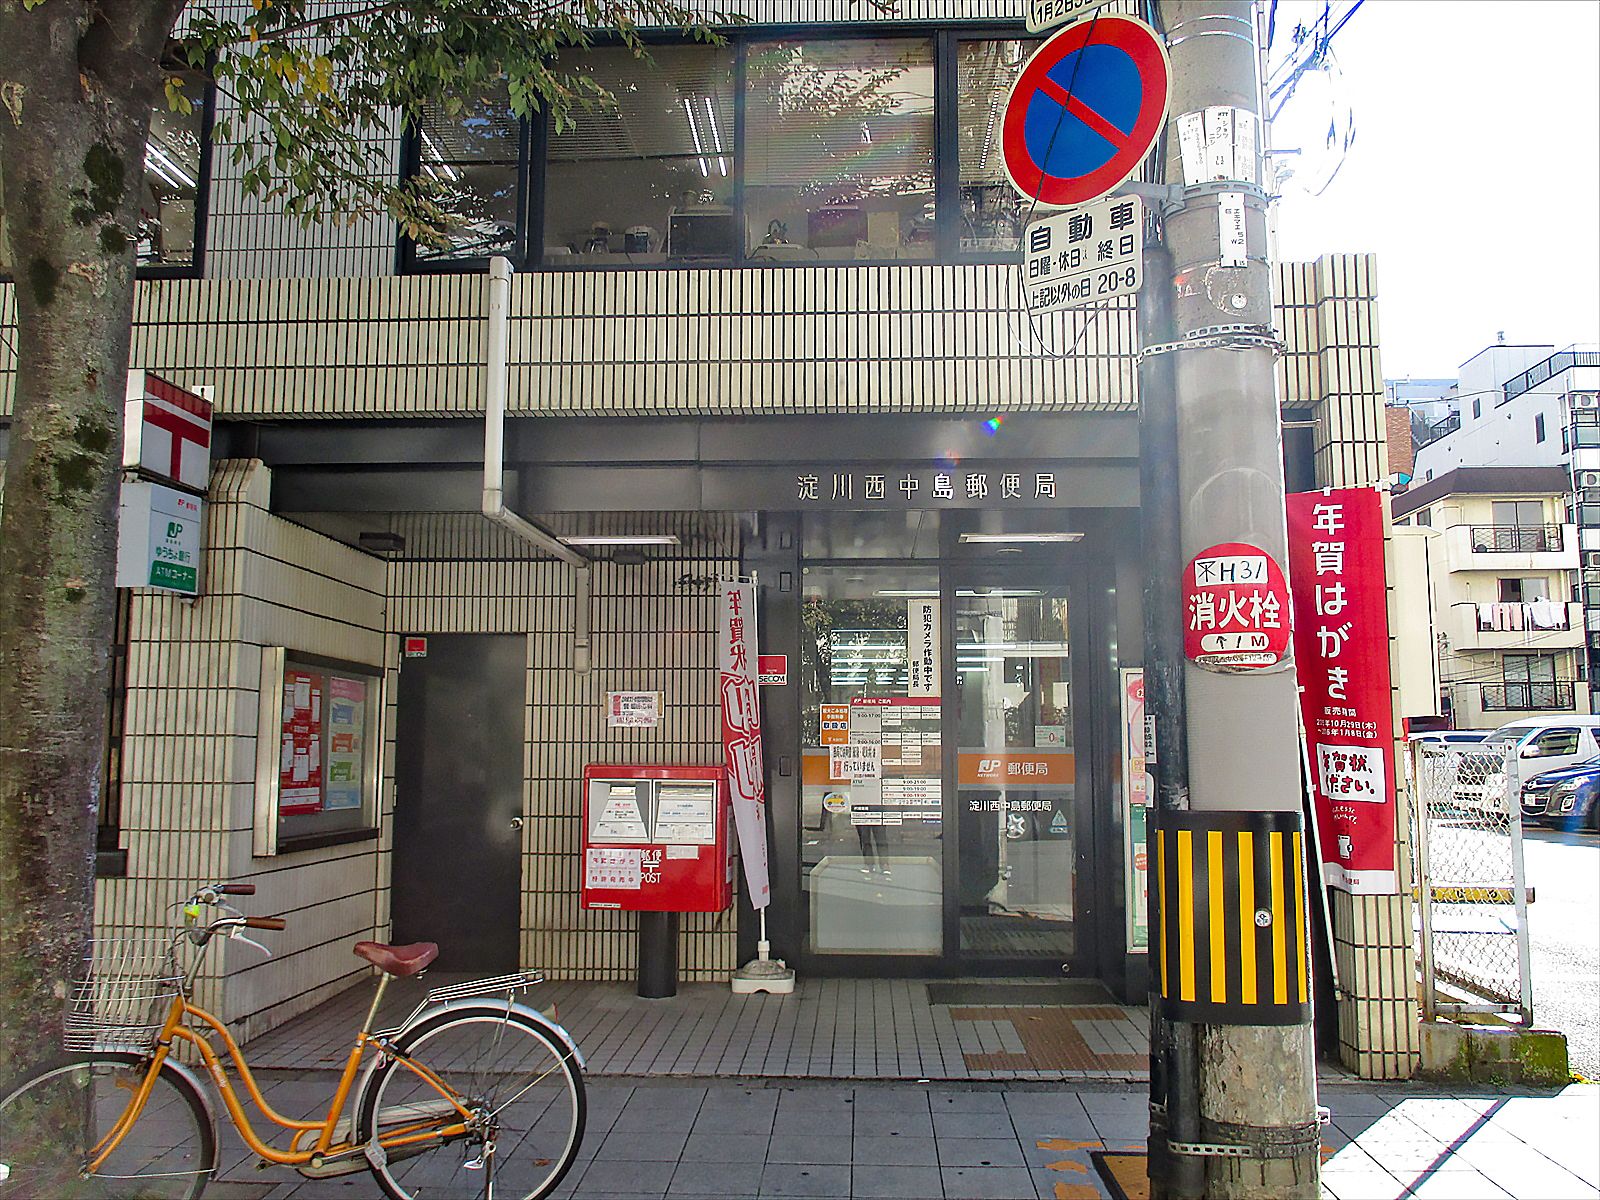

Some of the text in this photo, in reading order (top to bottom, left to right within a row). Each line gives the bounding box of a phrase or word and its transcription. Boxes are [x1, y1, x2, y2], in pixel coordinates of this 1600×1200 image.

[1030, 201, 1135, 254] 自動車
[1097, 233, 1134, 262] 終日
[1029, 266, 1136, 310] 上記以外の日 20-8
[797, 472, 1057, 500] 淀川西中島郵便局
[1188, 589, 1281, 631] 消火栓
[1311, 503, 1353, 700] 年賀はがき
[922, 605, 933, 692] 防犯カメラ作動中です
[757, 675, 785, 683] SECOM
[912, 660, 920, 688] 郵便局長
[977, 759, 1002, 773] JP
[1007, 762, 1048, 776] 郵便局
[968, 800, 1052, 812] 淀川西中島郵便局
[640, 872, 662, 883] POST
